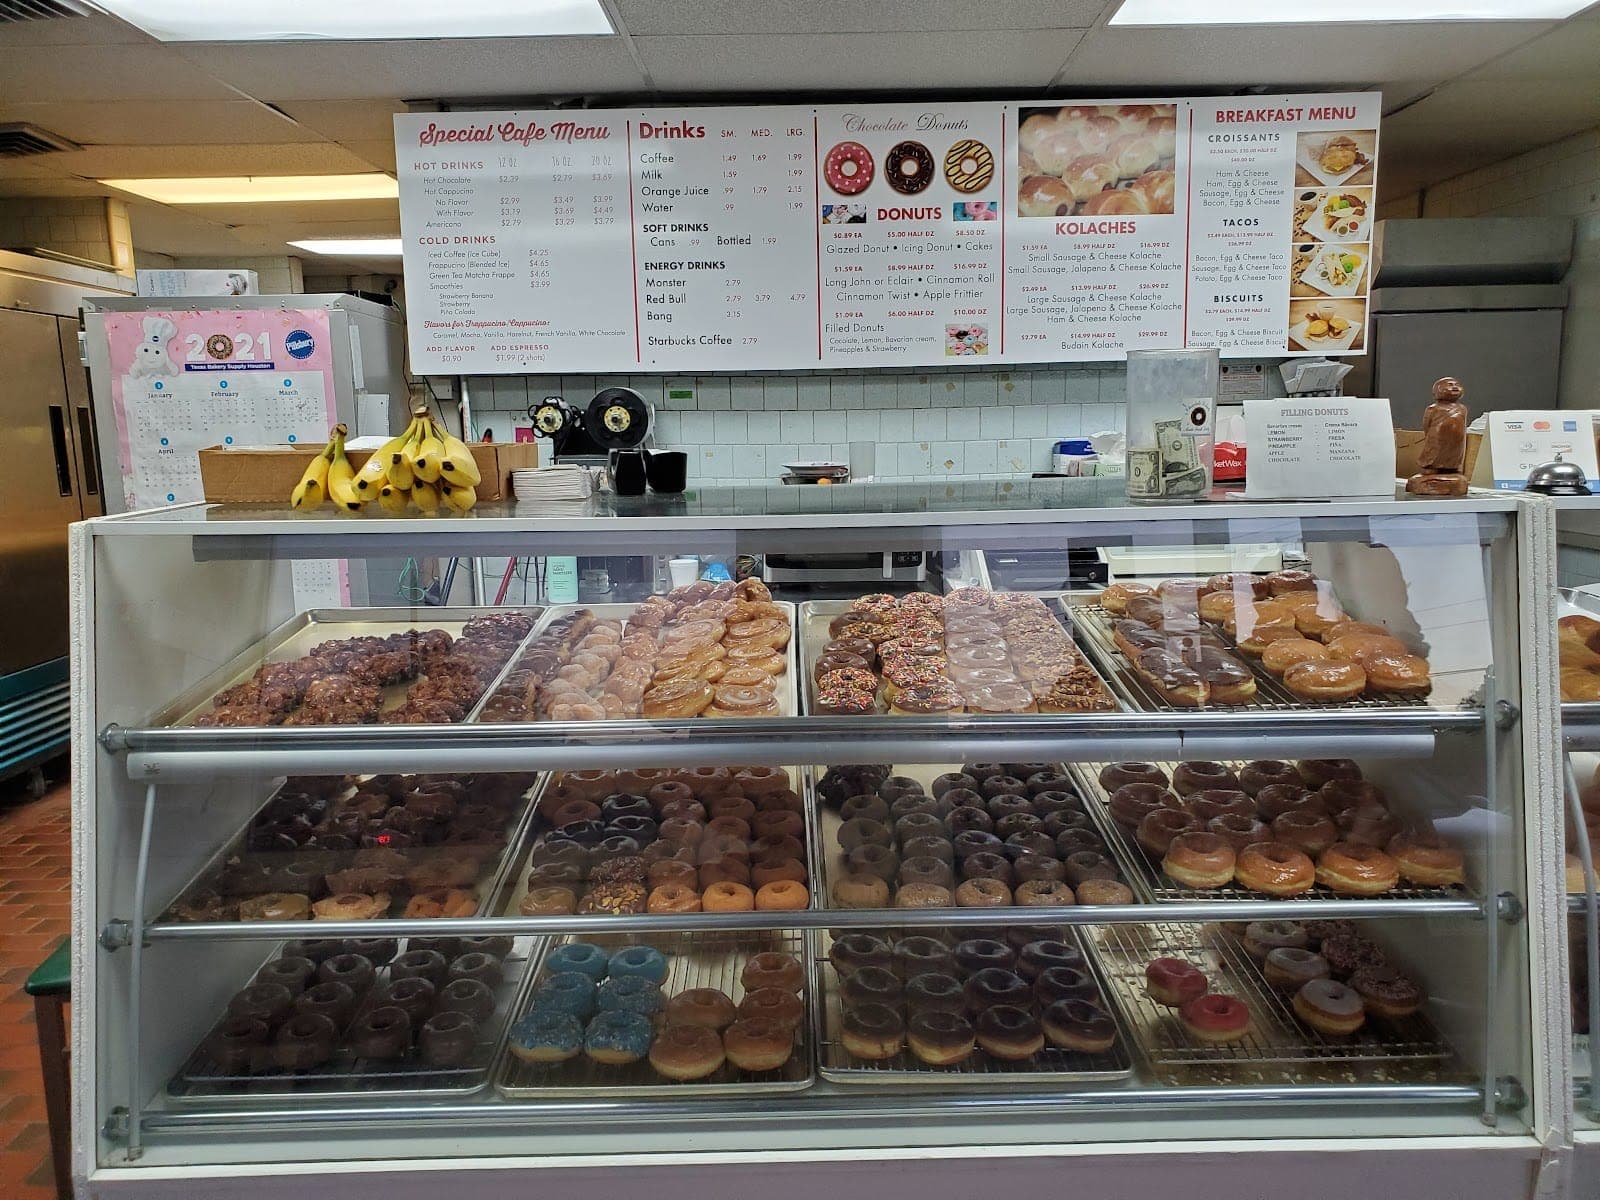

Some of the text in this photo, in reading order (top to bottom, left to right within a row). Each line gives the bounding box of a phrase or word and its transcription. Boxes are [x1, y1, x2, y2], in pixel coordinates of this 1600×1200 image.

[1216, 107, 1356, 123] BREAKFAST MENU
[842, 112, 968, 132] Chocolate Donuts
[419, 121, 610, 147] Special Cafe Menu
[639, 120, 705, 139] Drinks
[751, 129, 772, 137] MED.
[1208, 133, 1280, 142] CROISSANTS
[640, 154, 673, 163] Coffee
[414, 161, 483, 170] HOT DRINKS
[642, 170, 662, 179] Milk
[438, 176, 471, 184] Chocolate
[1228, 180, 1241, 188] Egg
[642, 187, 680, 198] Orange
[684, 186, 709, 196] Juice
[1200, 190, 1229, 198] Sausage,
[1235, 190, 1248, 198] Egg
[642, 203, 673, 212] Water
[1230, 199, 1243, 207] Egg
[878, 208, 942, 220] DONUTS
[1223, 219, 1259, 227] TACOS
[671, 224, 708, 232] DRINKS
[1056, 222, 1136, 235] KOLACHES
[419, 236, 495, 245] COLD DRINKS
[650, 237, 675, 246] Cans
[717, 235, 751, 245] Bottled
[827, 242, 992, 254] Glazed Donut Icing Donut Cakes
[1029, 251, 1161, 263] Small Sausage Cheese Kolache
[1220, 254, 1232, 262] Egg
[645, 261, 725, 270] ENERGY DRINKS
[1224, 265, 1235, 273] Egg
[1008, 266, 1029, 274] Small
[1033, 266, 1068, 275] Sausage,
[430, 272, 450, 280] Green
[492, 271, 515, 279] Frappe
[1219, 275, 1232, 283] Egg
[646, 278, 686, 287] Monster
[825, 273, 994, 288] Long John or Eclair Cinnamon Roll
[646, 294, 665, 304] Red
[669, 293, 686, 303] Bull
[837, 290, 950, 301] Cinnamon Twist Apple
[1028, 296, 1049, 305] Large
[1052, 295, 1085, 304] Sausage
[1098, 294, 1126, 302] Cheese
[1007, 303, 1182, 315] Large Sausage, Cheese Kolache
[647, 311, 672, 322] Bang
[1110, 314, 1141, 322] Kolache
[424, 320, 451, 329] Flavors
[825, 323, 884, 333] Filled Donuts
[1216, 330, 1228, 338] Egg
[286, 339, 314, 351] Pillsbury
[648, 336, 695, 346] Starbucks
[700, 335, 732, 344] Coffee
[1092, 341, 1123, 349] Kolache
[830, 345, 906, 354] Pineapples Strawberry
